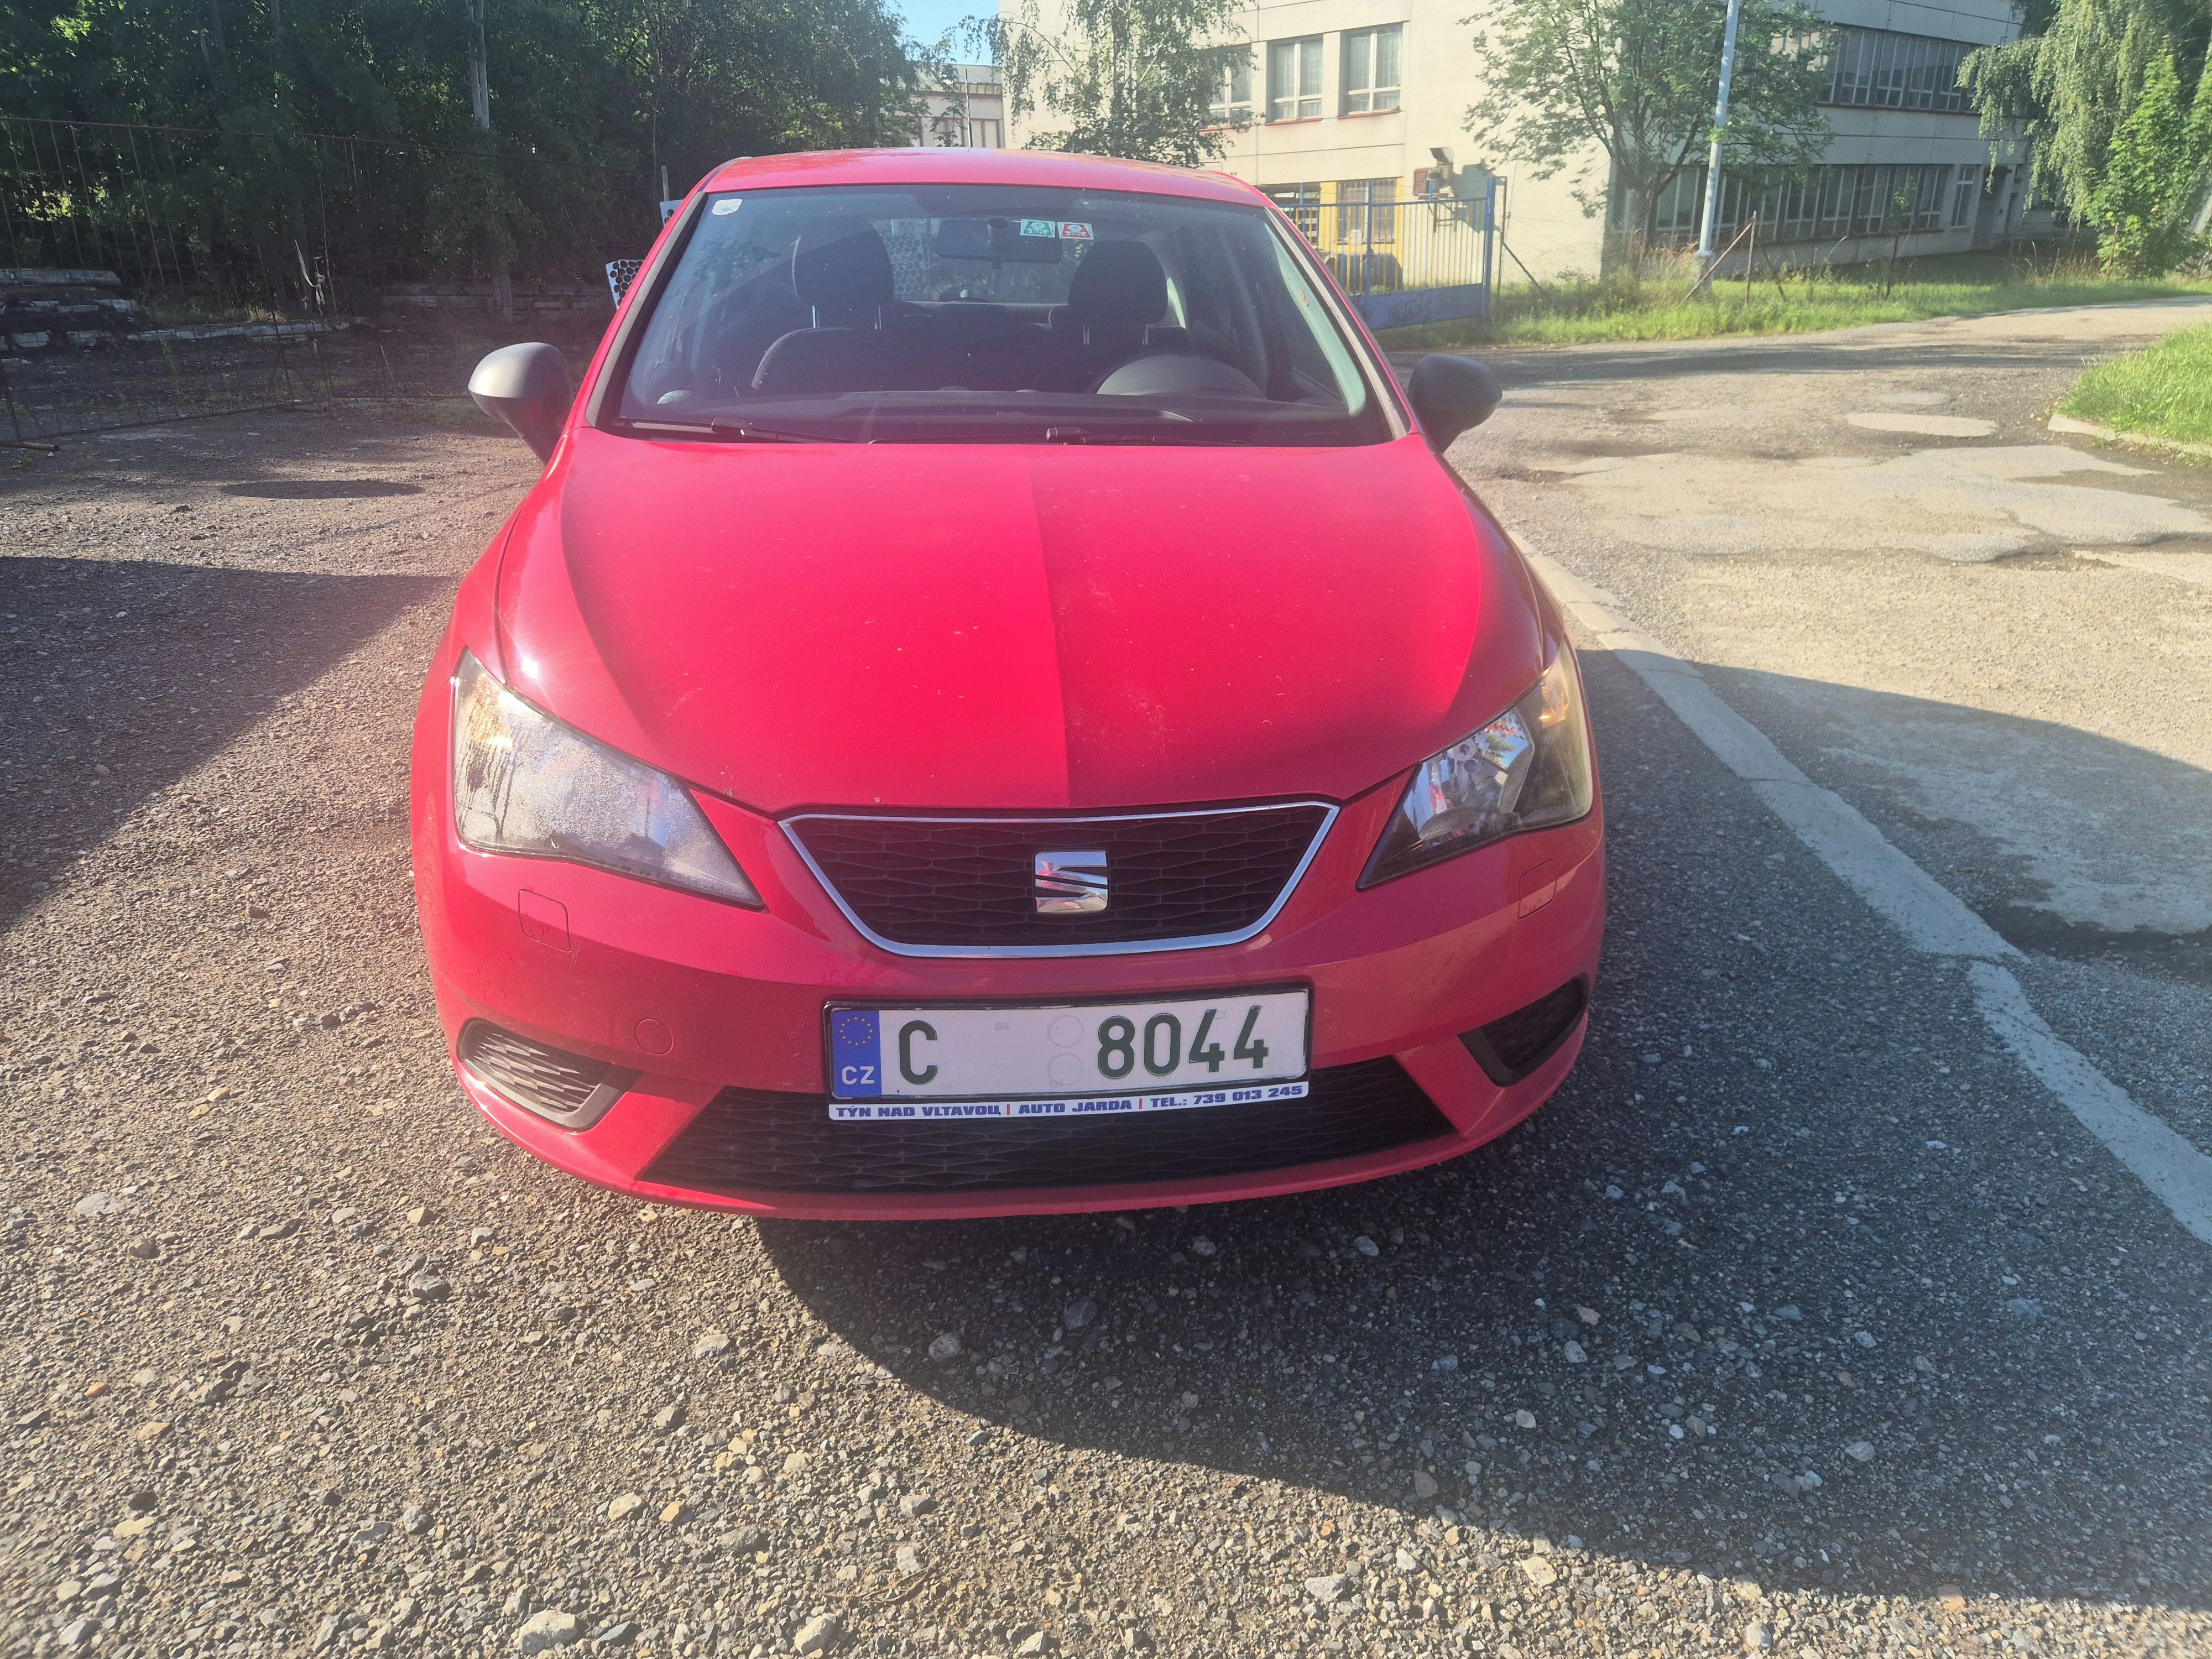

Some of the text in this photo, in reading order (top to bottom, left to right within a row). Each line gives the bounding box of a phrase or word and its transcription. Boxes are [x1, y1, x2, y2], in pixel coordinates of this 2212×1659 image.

[899, 1005, 1269, 1085] C 8044
[842, 1066, 875, 1085] CZ
[836, 1085, 1302, 1117] TÝN NAD VLTAVOU AUTO JARDA TEL.: 739 013 245
